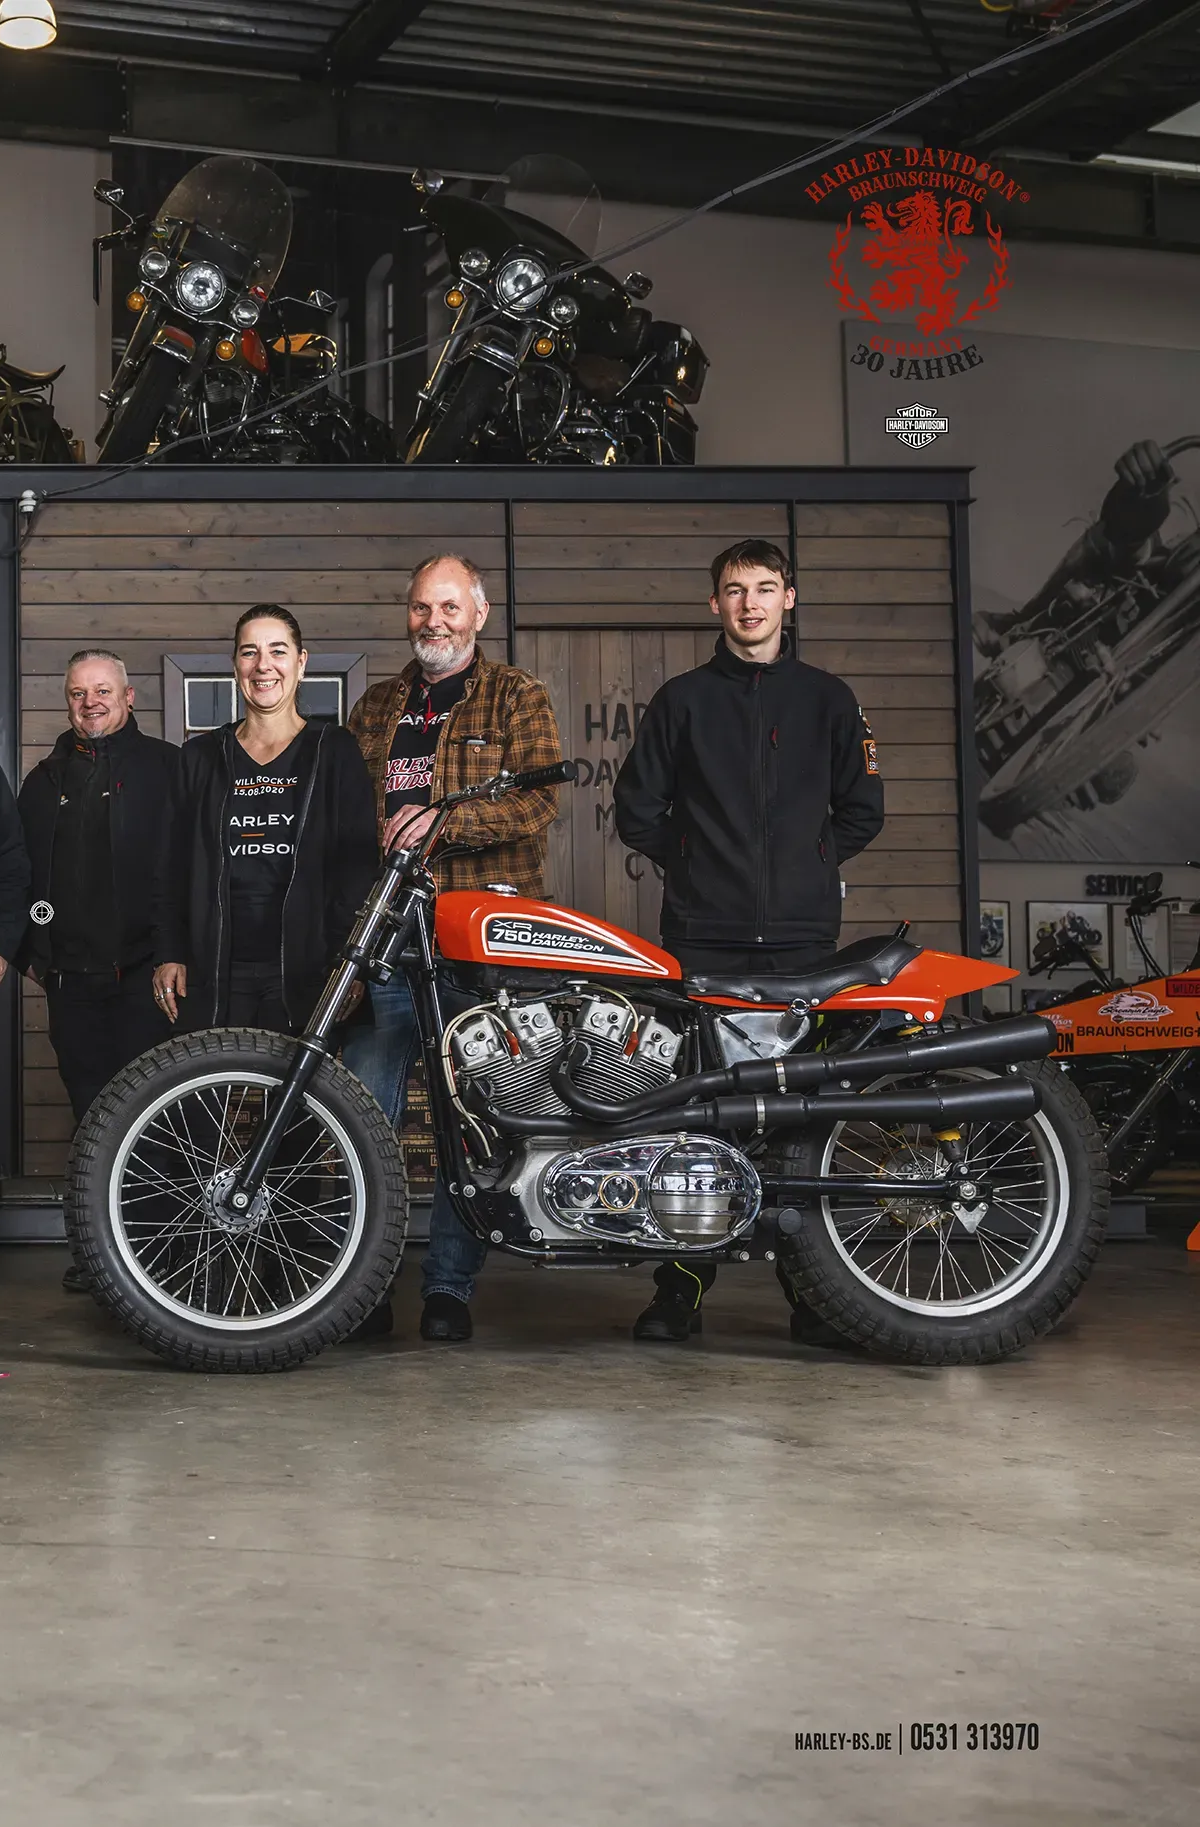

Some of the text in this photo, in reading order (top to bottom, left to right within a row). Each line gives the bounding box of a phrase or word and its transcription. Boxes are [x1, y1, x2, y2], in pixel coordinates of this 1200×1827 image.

[256, 775, 284, 785] ROCK
[233, 785, 285, 797] 15.08.2020
[1085, 874, 1148, 896] SERVIC
[493, 919, 533, 932] XR
[492, 928, 533, 943] 750
[531, 938, 605, 952] DAVIDSON
